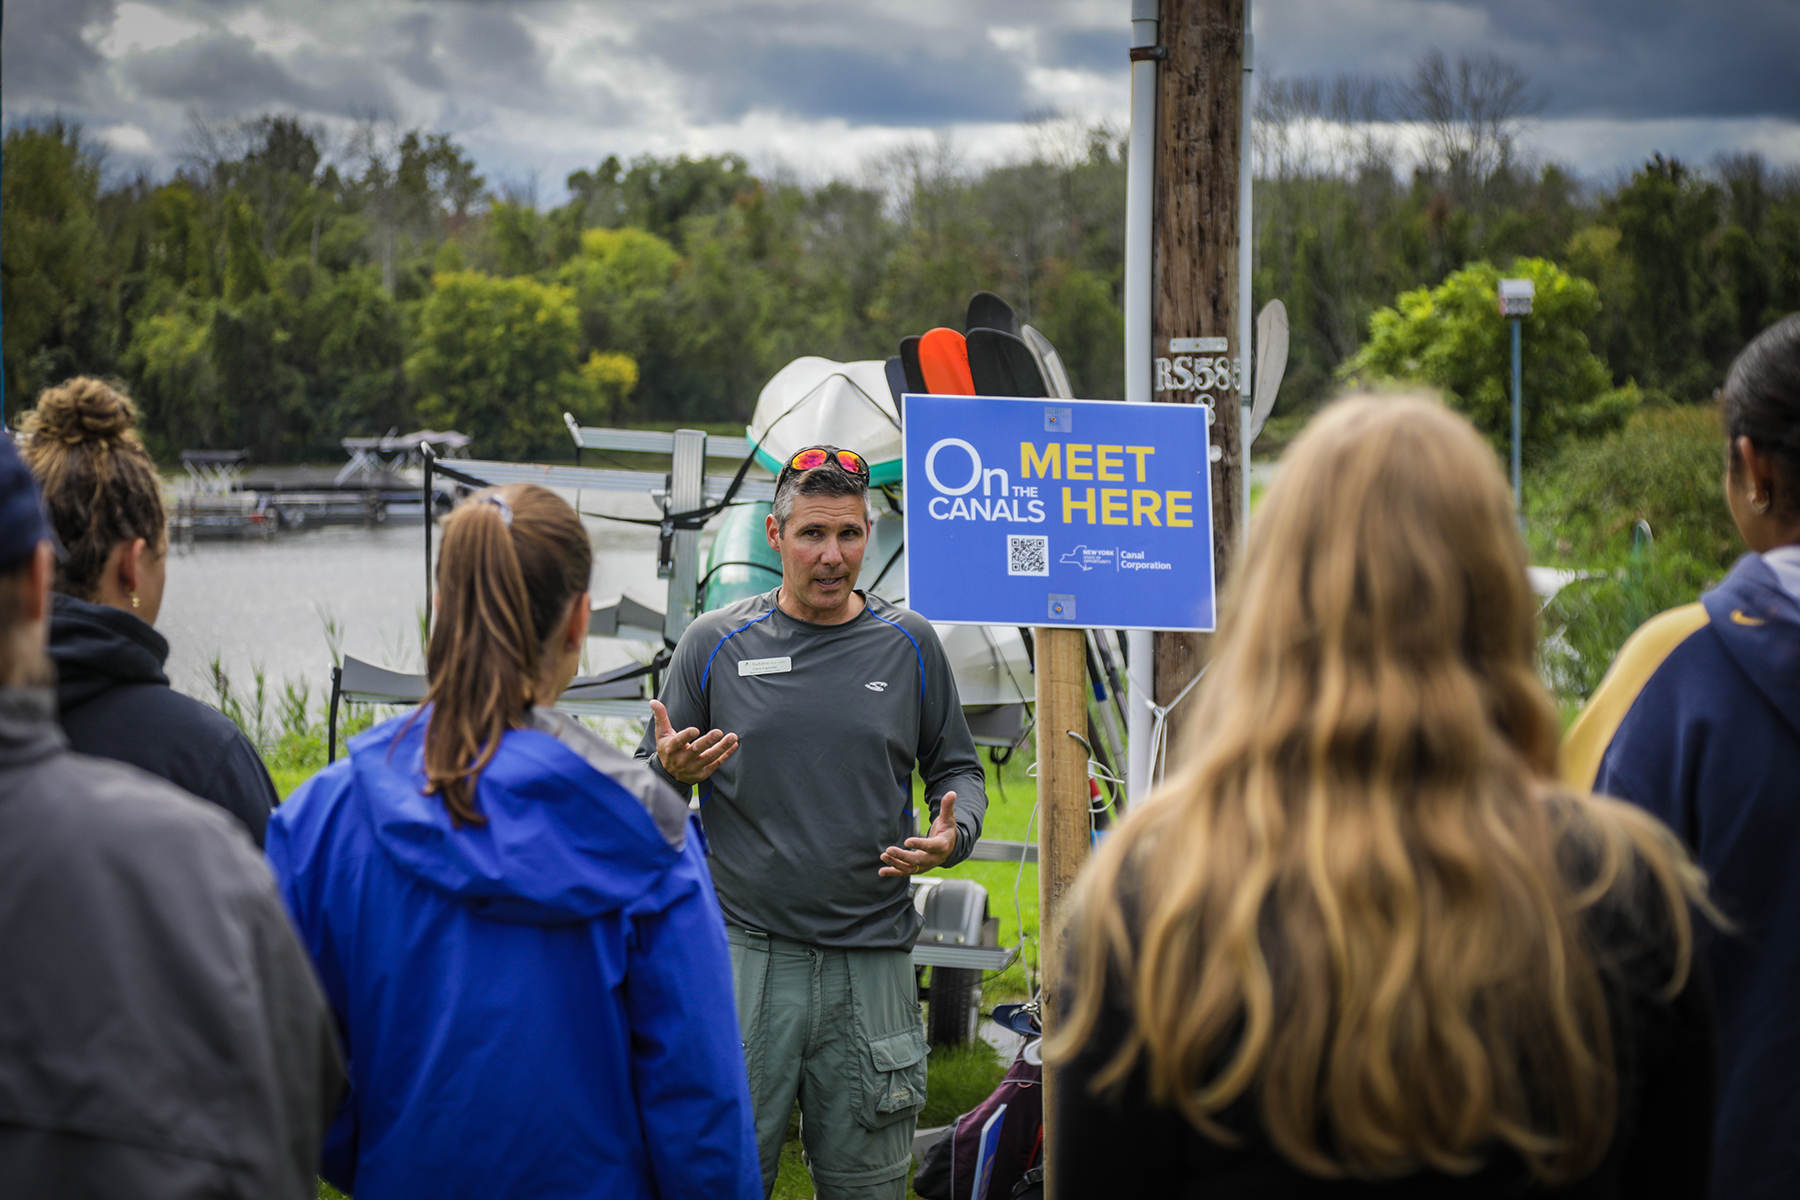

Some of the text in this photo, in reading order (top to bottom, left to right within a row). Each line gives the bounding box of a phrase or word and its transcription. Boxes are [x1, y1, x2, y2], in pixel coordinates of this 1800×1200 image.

[925, 438, 1038, 497] On THE
[1020, 442, 1155, 482] MEET
[928, 496, 1046, 523] CANALS
[1062, 487, 1193, 527] HERE
[1121, 551, 1144, 559] Canal
[1121, 561, 1171, 571] Corporation
